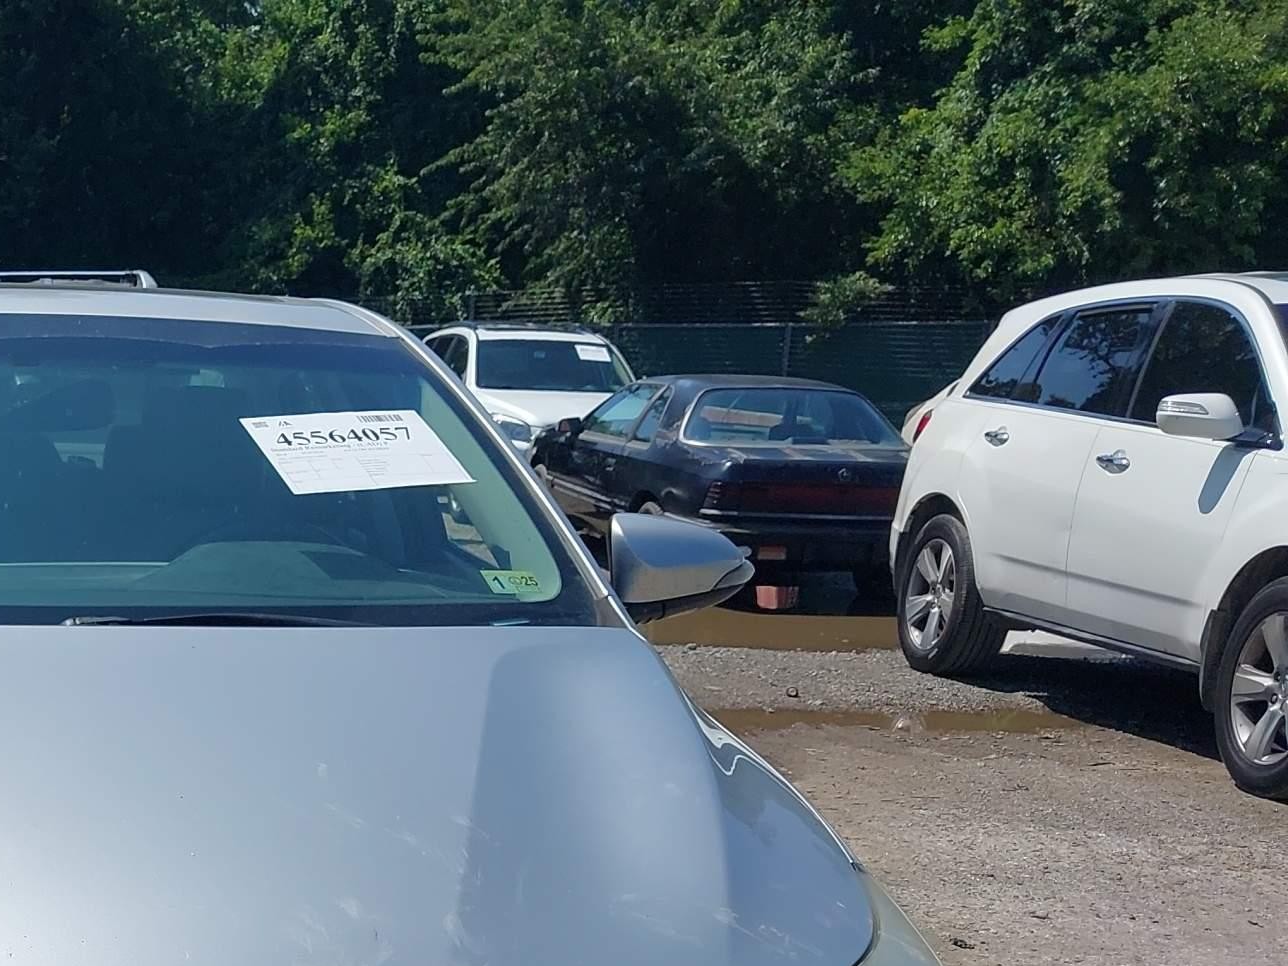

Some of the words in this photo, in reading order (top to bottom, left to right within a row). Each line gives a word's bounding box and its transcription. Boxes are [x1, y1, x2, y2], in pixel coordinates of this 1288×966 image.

[276, 426, 412, 447] 45564057
[492, 575, 506, 590] 1
[520, 575, 539, 587] 25
